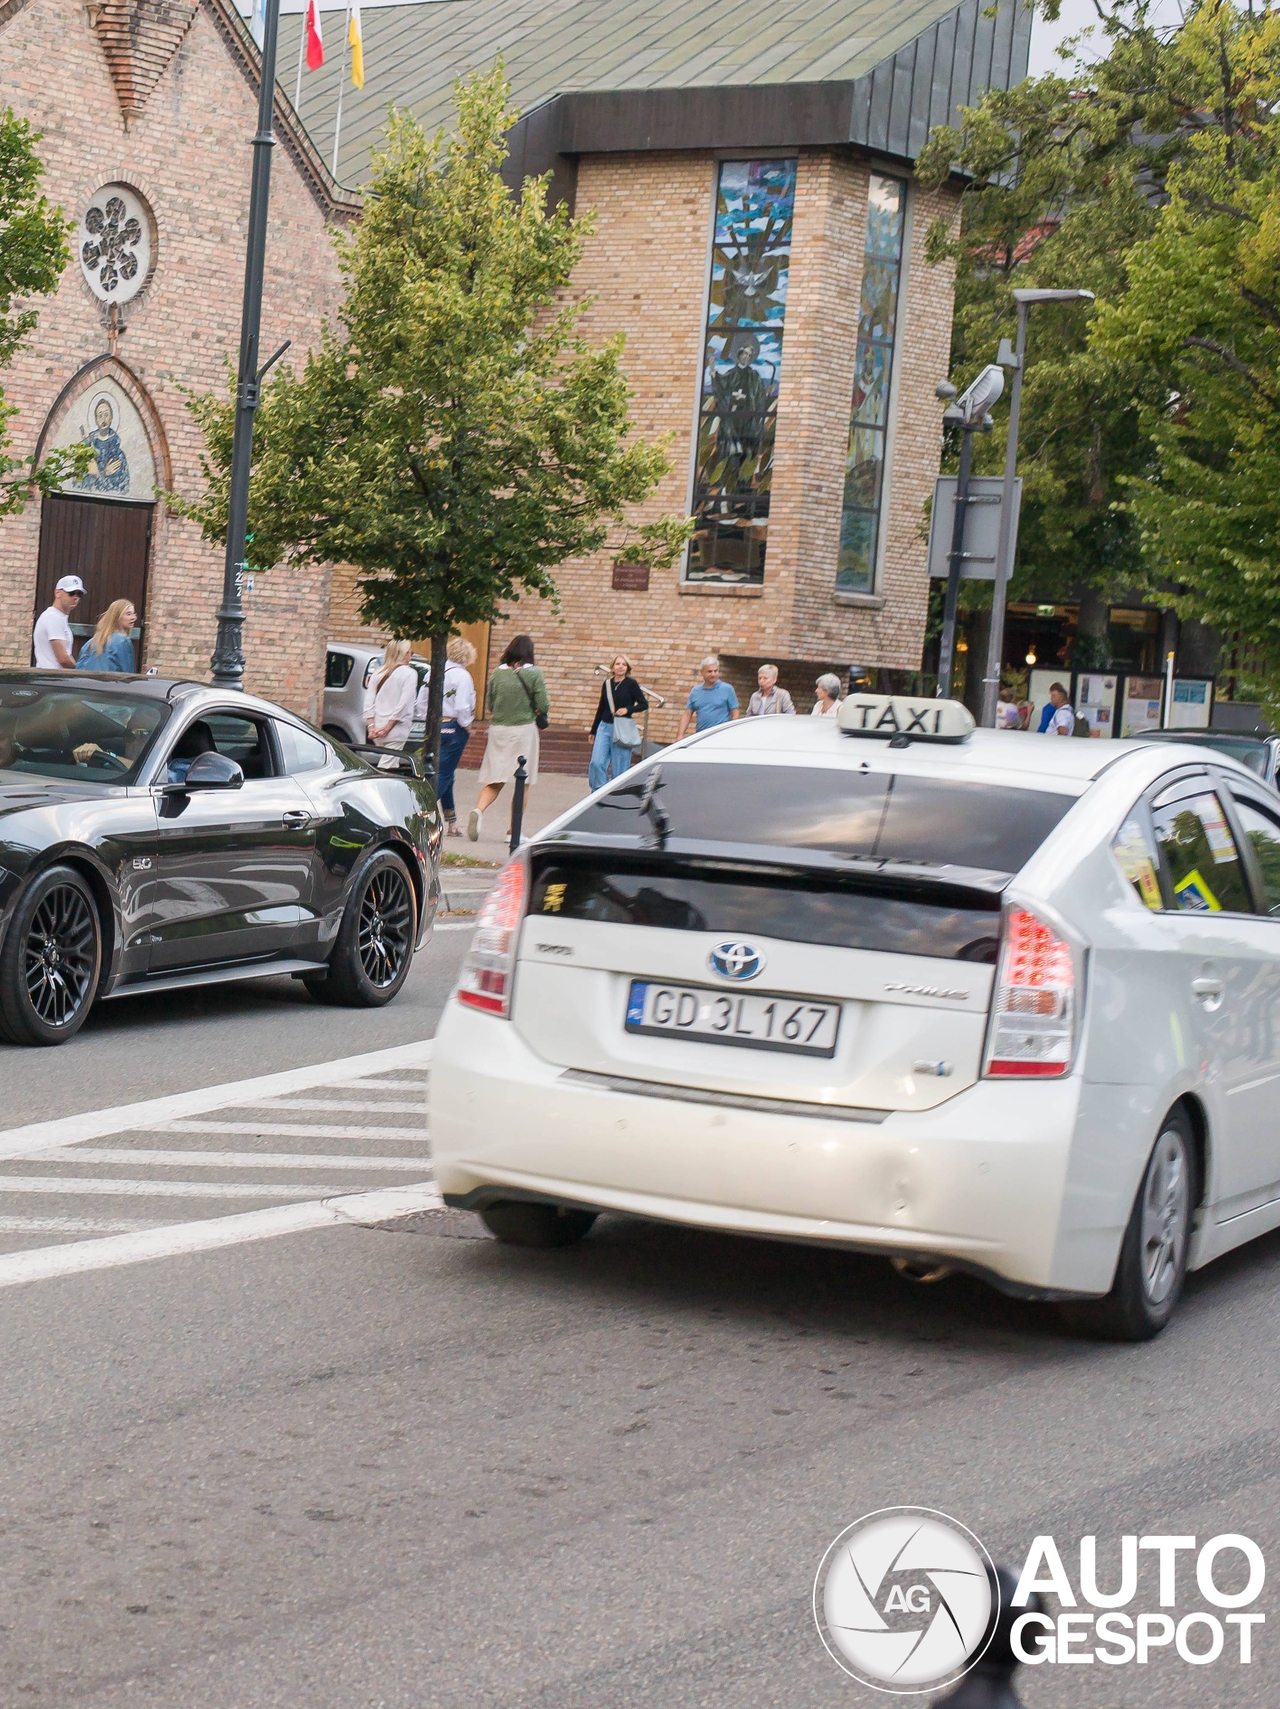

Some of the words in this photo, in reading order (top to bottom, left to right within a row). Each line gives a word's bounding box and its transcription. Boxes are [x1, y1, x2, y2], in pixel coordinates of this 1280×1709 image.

[855, 701, 942, 734] TAXI
[651, 989, 699, 1027] GD
[711, 996, 830, 1043] 3L167
